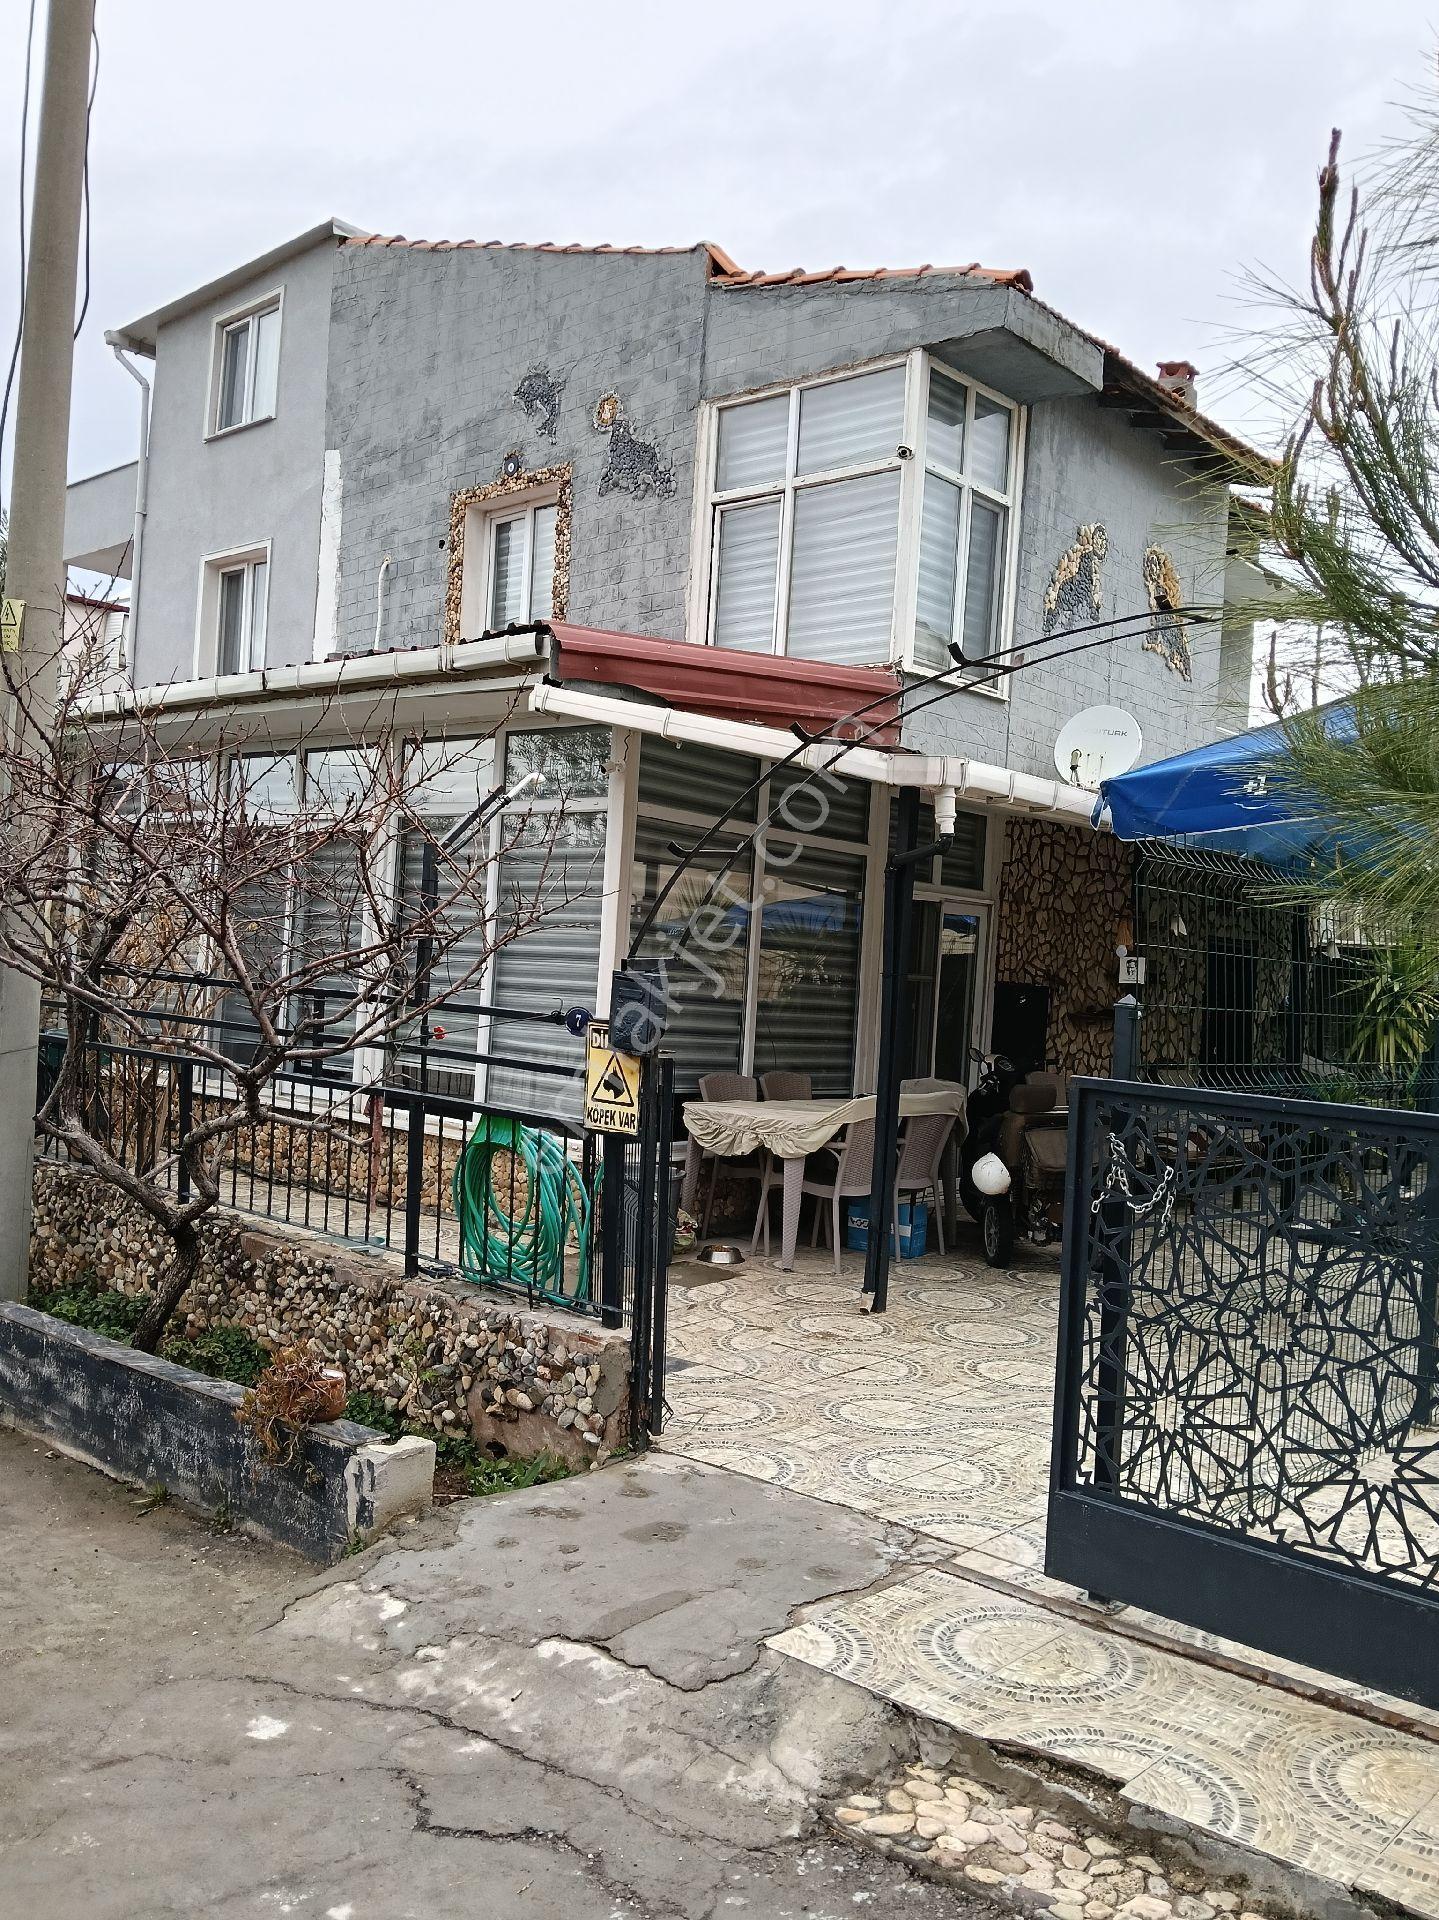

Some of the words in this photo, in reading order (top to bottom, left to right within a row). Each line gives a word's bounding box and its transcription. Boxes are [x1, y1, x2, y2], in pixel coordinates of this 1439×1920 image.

[575, 1013, 582, 1028] 7
[587, 1104, 616, 1127] KÖPEK
[618, 1110, 636, 1130] VAR
